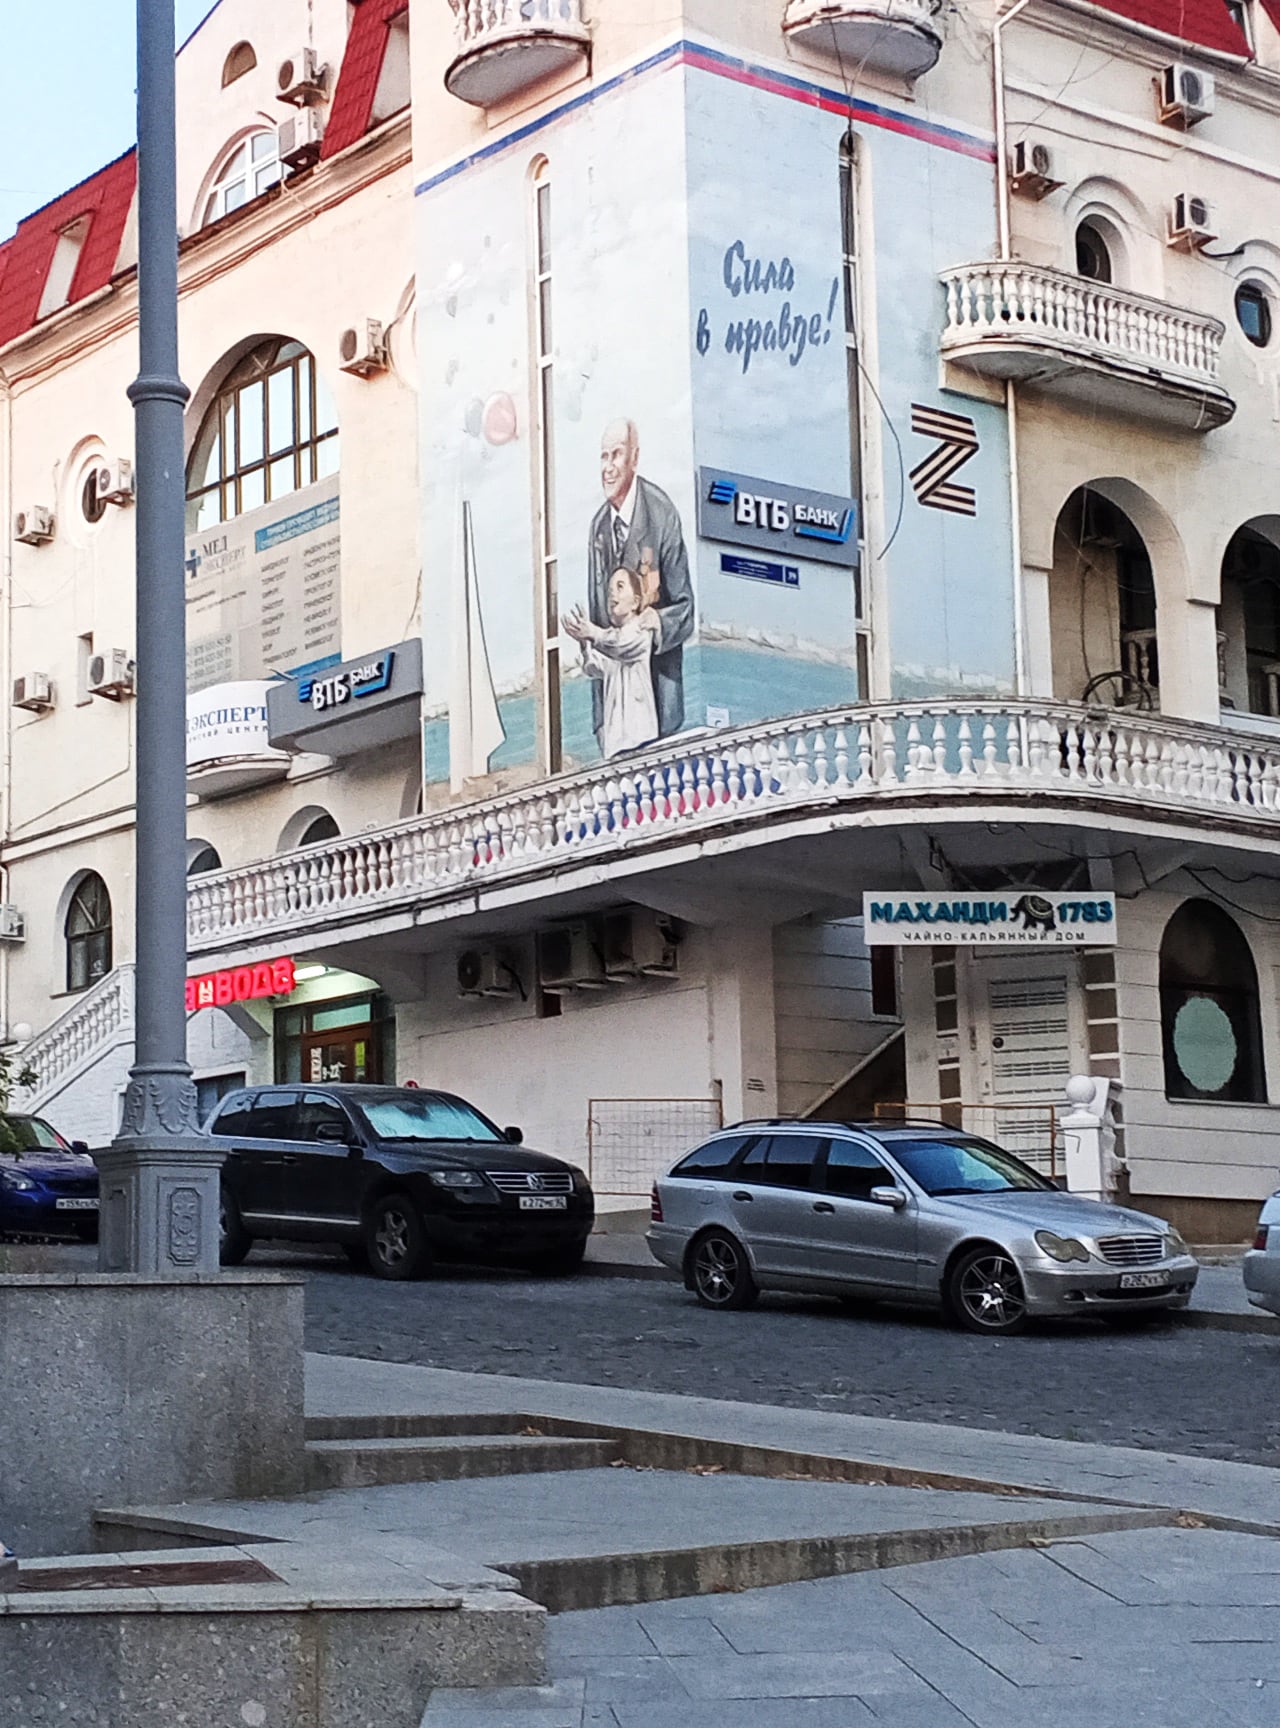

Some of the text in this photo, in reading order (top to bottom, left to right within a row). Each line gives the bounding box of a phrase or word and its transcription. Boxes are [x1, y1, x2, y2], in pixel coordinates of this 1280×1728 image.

[723, 239, 795, 297] Сила
[696, 308, 711, 357] в
[735, 492, 839, 530] ВТБ БАНК
[312, 662, 383, 711] ВТБ БАНК
[870, 900, 1113, 924] МАХАНДИ 1783
[1055, 931, 1086, 942] ДОМ
